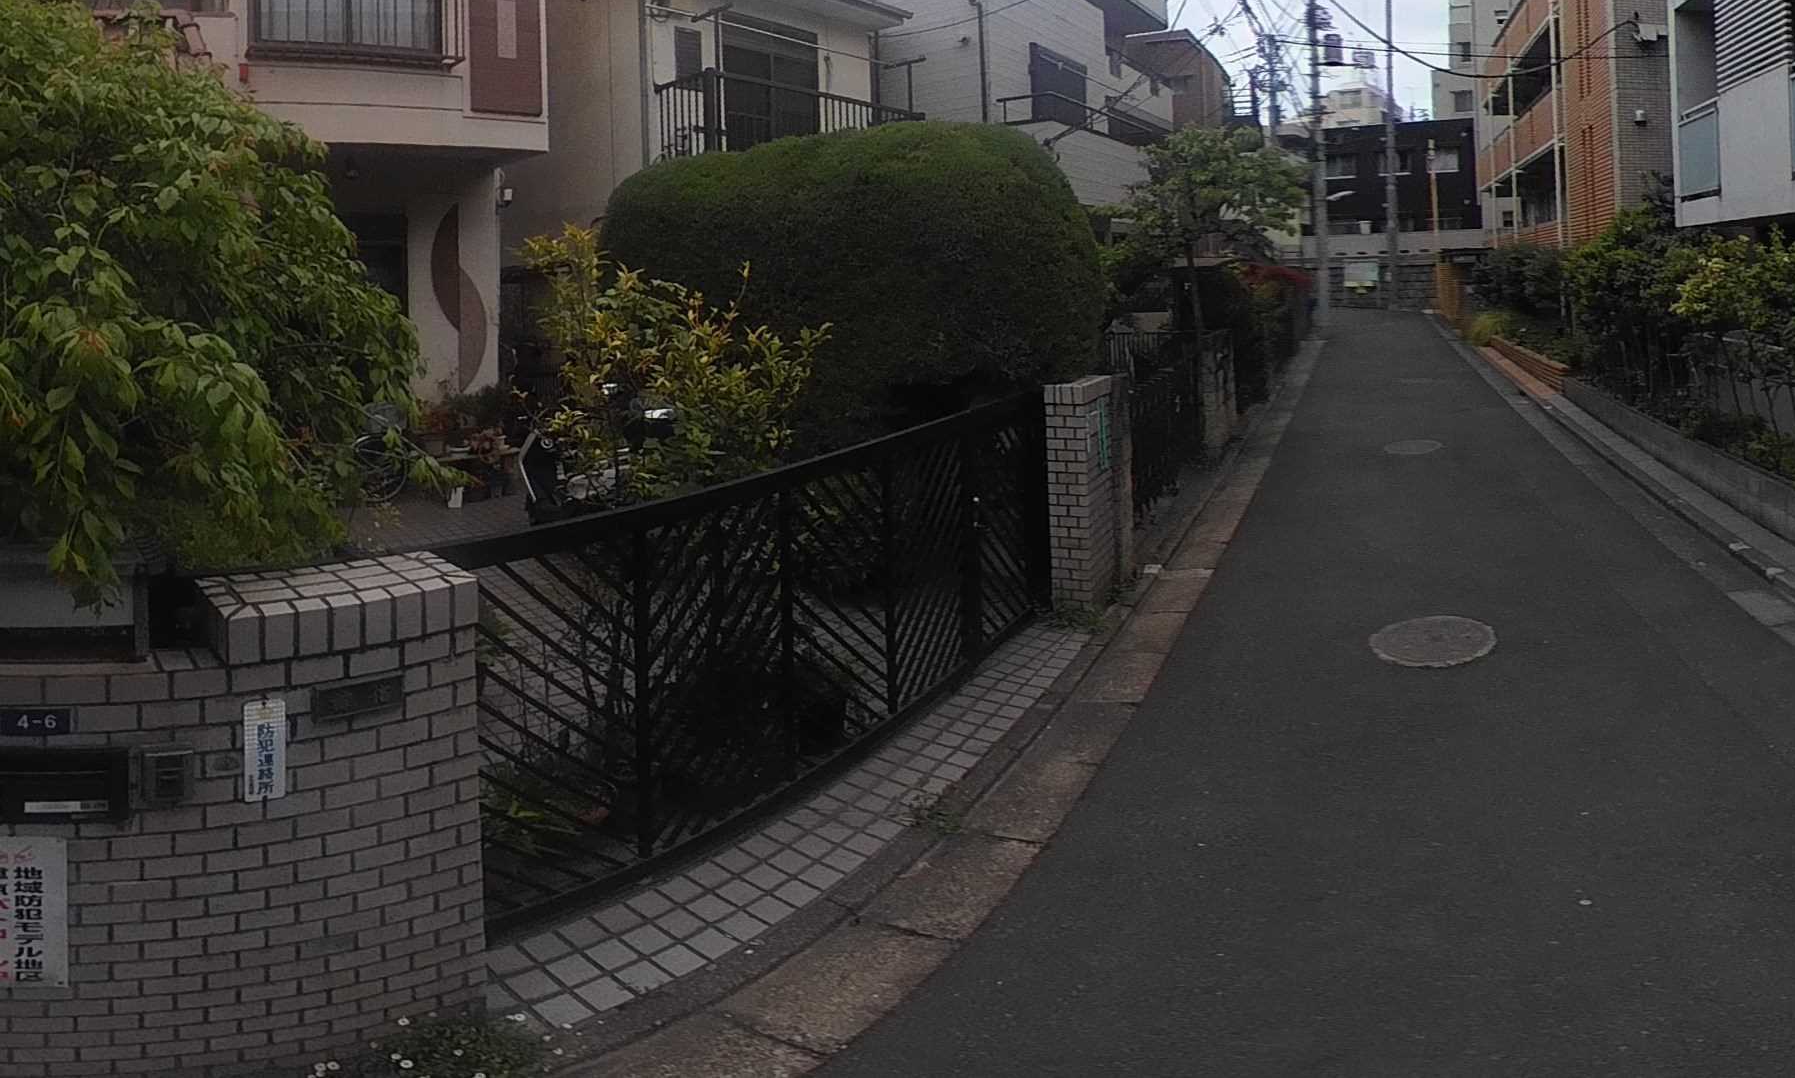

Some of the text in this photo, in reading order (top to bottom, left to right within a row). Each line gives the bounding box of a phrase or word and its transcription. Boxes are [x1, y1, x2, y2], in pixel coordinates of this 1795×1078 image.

[16, 714, 57, 729] 4-6
[256, 722, 275, 795] 防犯連絡所
[13, 866, 44, 982] 地域防犯モデル地区
